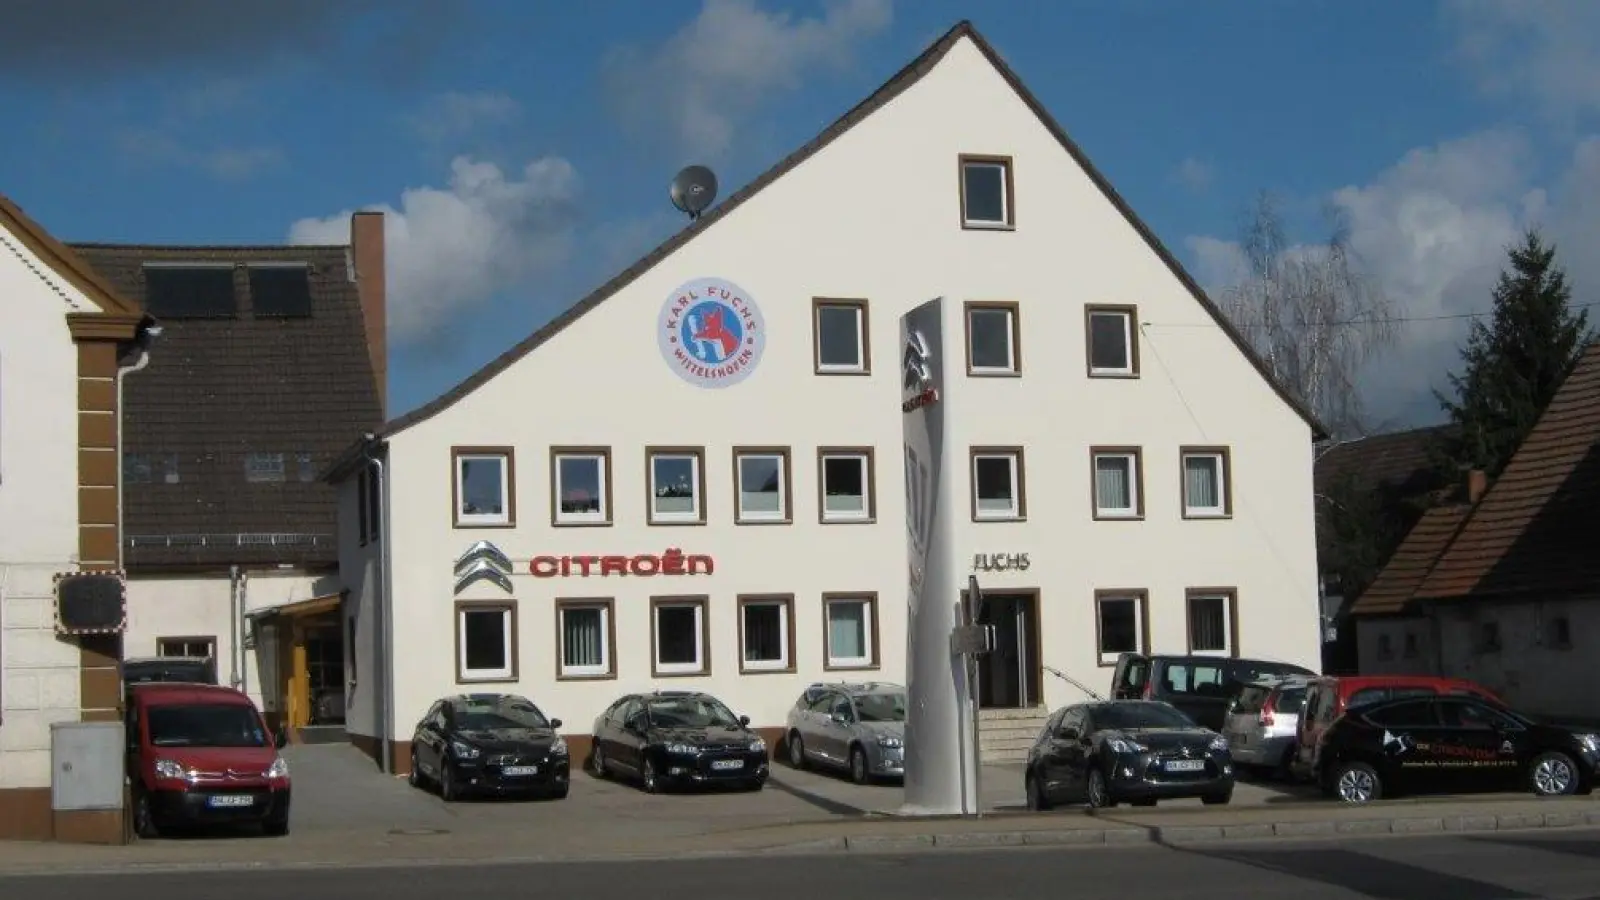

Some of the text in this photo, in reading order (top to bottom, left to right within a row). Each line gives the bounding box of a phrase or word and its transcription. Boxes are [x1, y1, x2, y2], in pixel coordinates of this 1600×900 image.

[666, 286, 757, 331] KARL FUCHS
[674, 348, 753, 379] WITTELSHOFEN
[974, 552, 1031, 572] FUCHS
